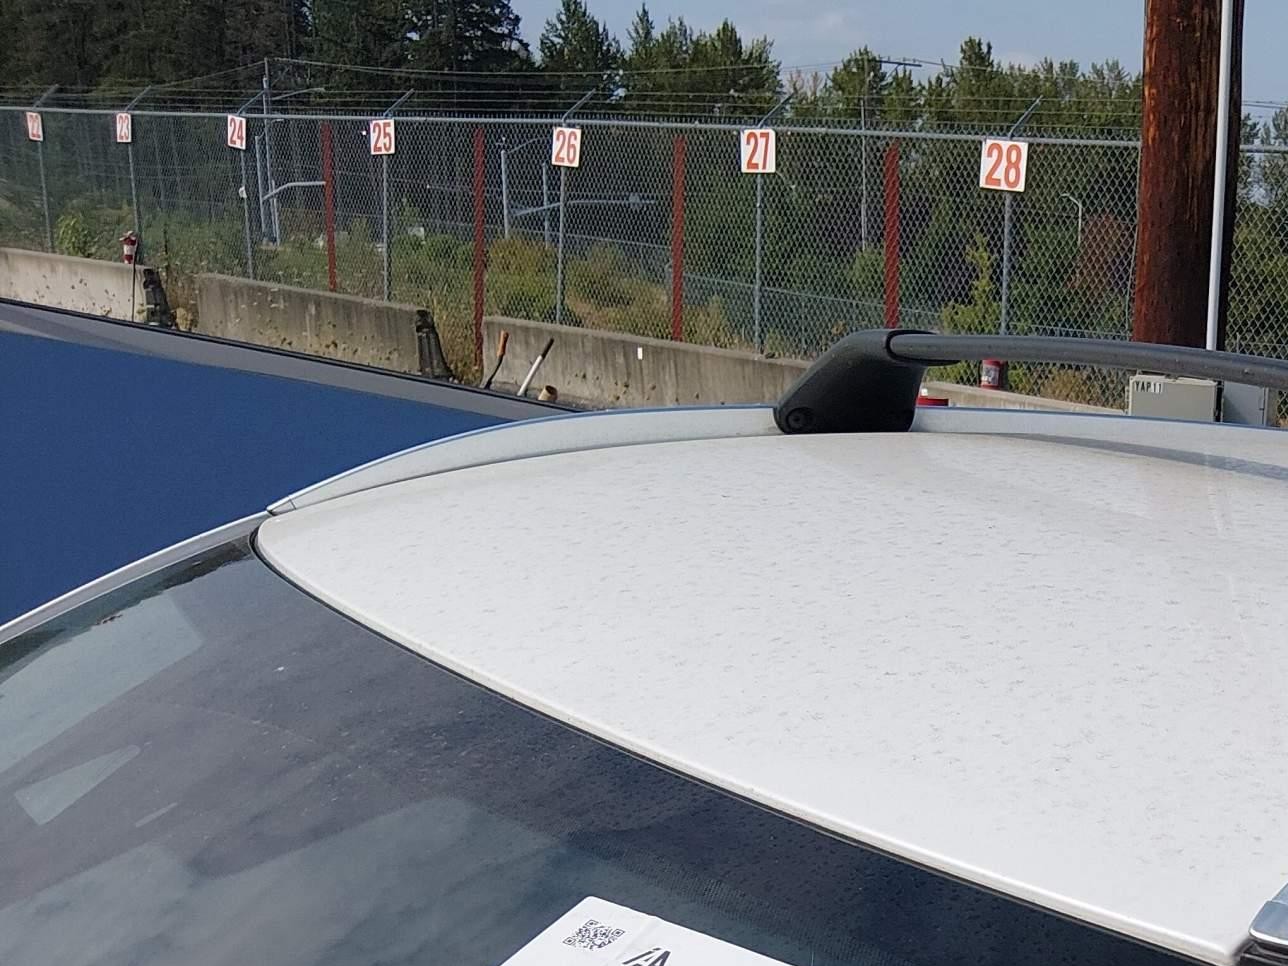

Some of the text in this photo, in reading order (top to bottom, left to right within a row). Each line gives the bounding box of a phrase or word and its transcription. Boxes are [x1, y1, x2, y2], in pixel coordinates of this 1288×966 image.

[229, 117, 244, 147] 24
[373, 121, 393, 152] 25
[554, 130, 577, 164] 26
[746, 131, 770, 170] 27
[985, 142, 1023, 189] 28
